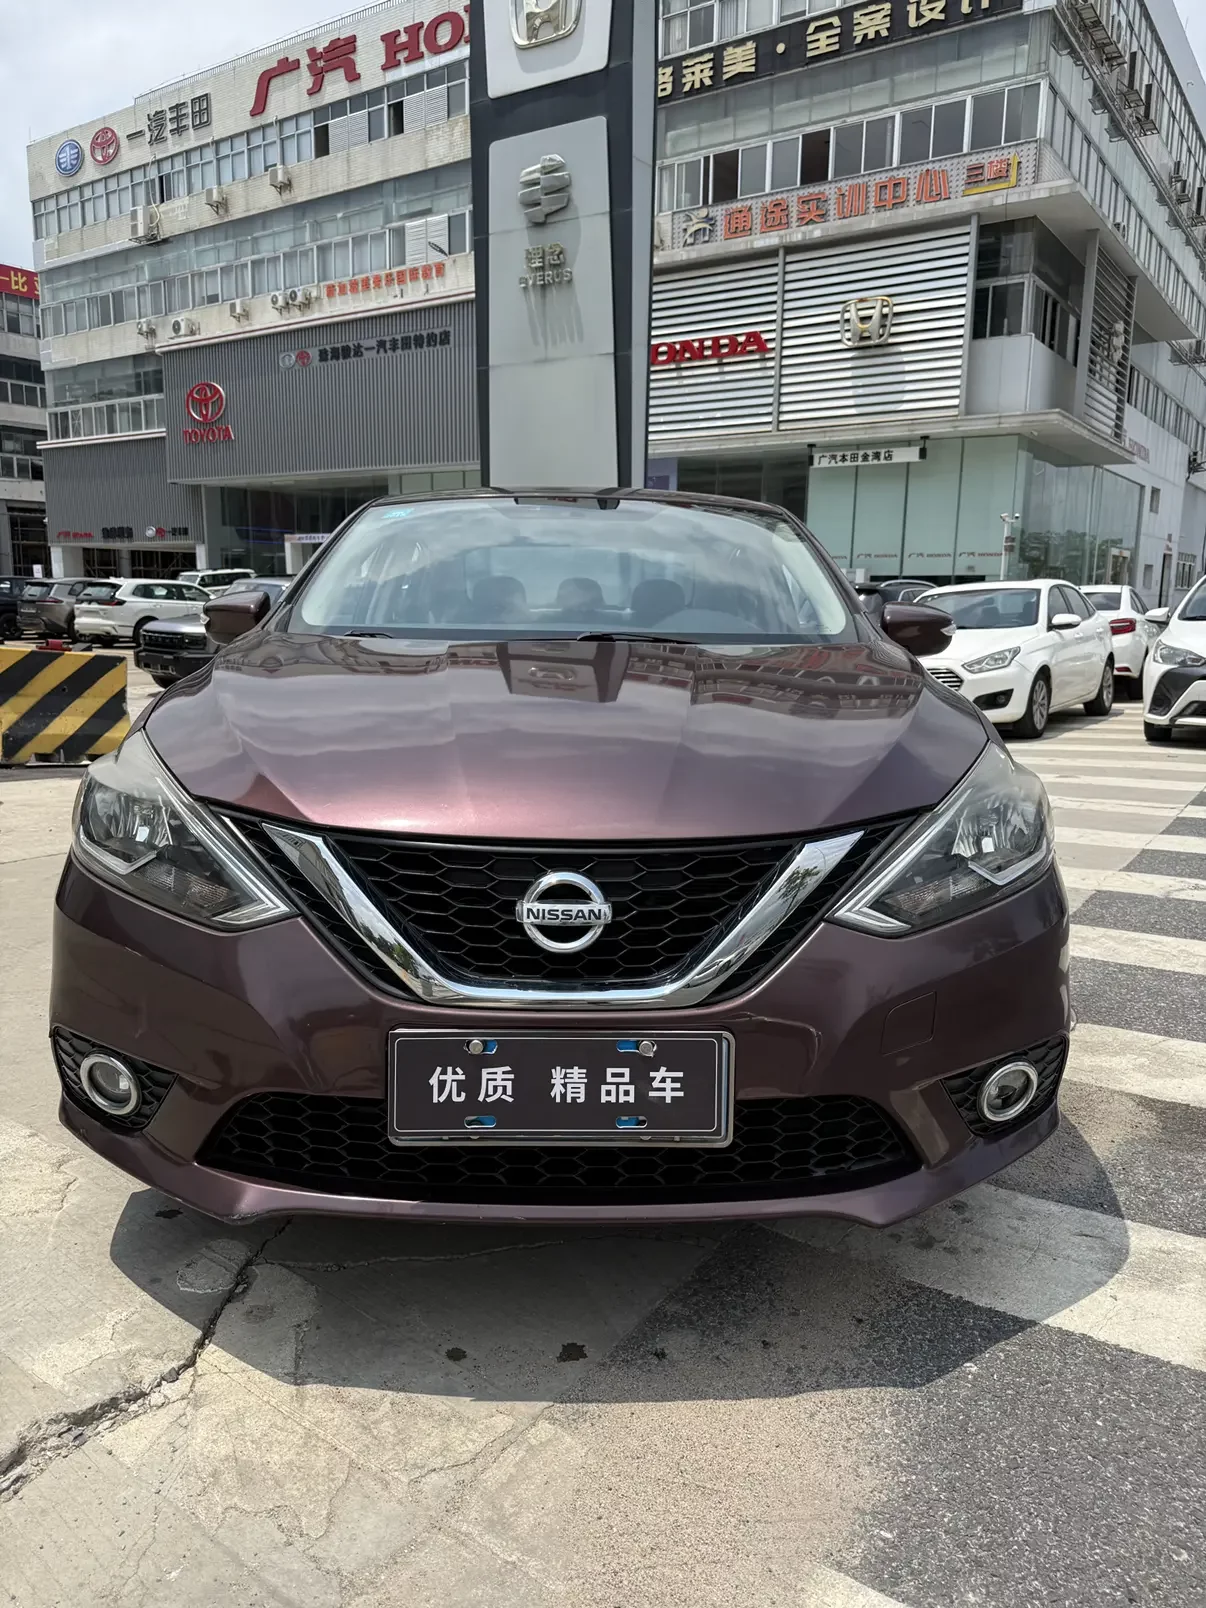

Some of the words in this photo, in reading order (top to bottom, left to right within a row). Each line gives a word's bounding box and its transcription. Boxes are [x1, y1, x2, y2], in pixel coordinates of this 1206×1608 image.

[250, 34, 361, 117] 广汽
[380, 4, 470, 71] HO
[126, 92, 212, 146] 一汽丰田
[723, 168, 950, 240] 通途实训中心
[965, 157, 1011, 183] 三楼
[523, 241, 565, 268] 理念
[183, 424, 235, 444] TOYOTA
[817, 450, 894, 465] 广汽本田金湾店
[526, 907, 602, 921] NISSAN
[428, 1065, 515, 1103] 优质
[550, 1065, 685, 1103] 精品车
